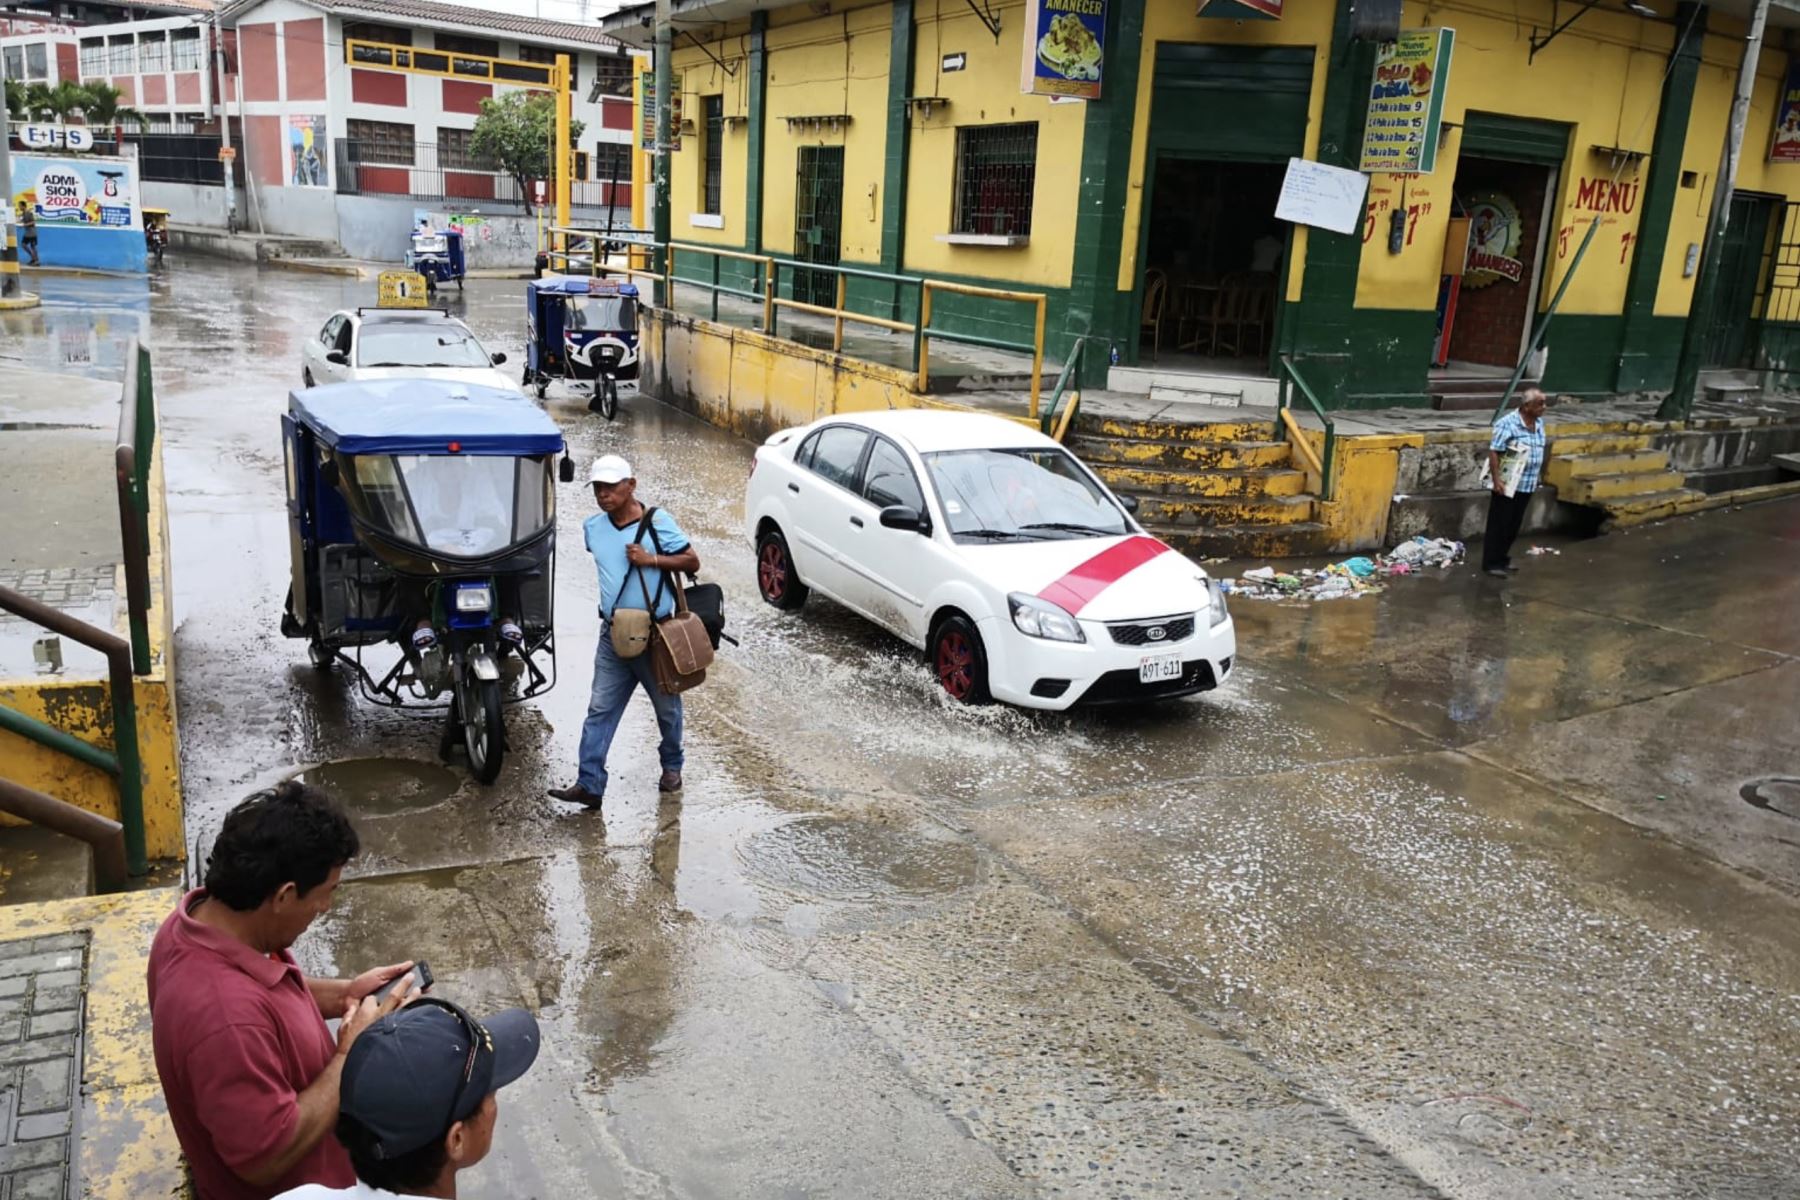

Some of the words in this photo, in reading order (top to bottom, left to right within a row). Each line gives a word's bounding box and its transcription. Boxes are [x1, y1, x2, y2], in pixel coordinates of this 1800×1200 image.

[1045, 0, 1102, 15] AMANECER
[1415, 101, 1422, 111] 9
[1406, 147, 1418, 156] 40
[46, 186, 77, 196] SION
[1575, 177, 1639, 214] MENÚ
[46, 196, 79, 207] 2020
[400, 281, 406, 297] 1
[1142, 660, 1180, 679] A9T-611
